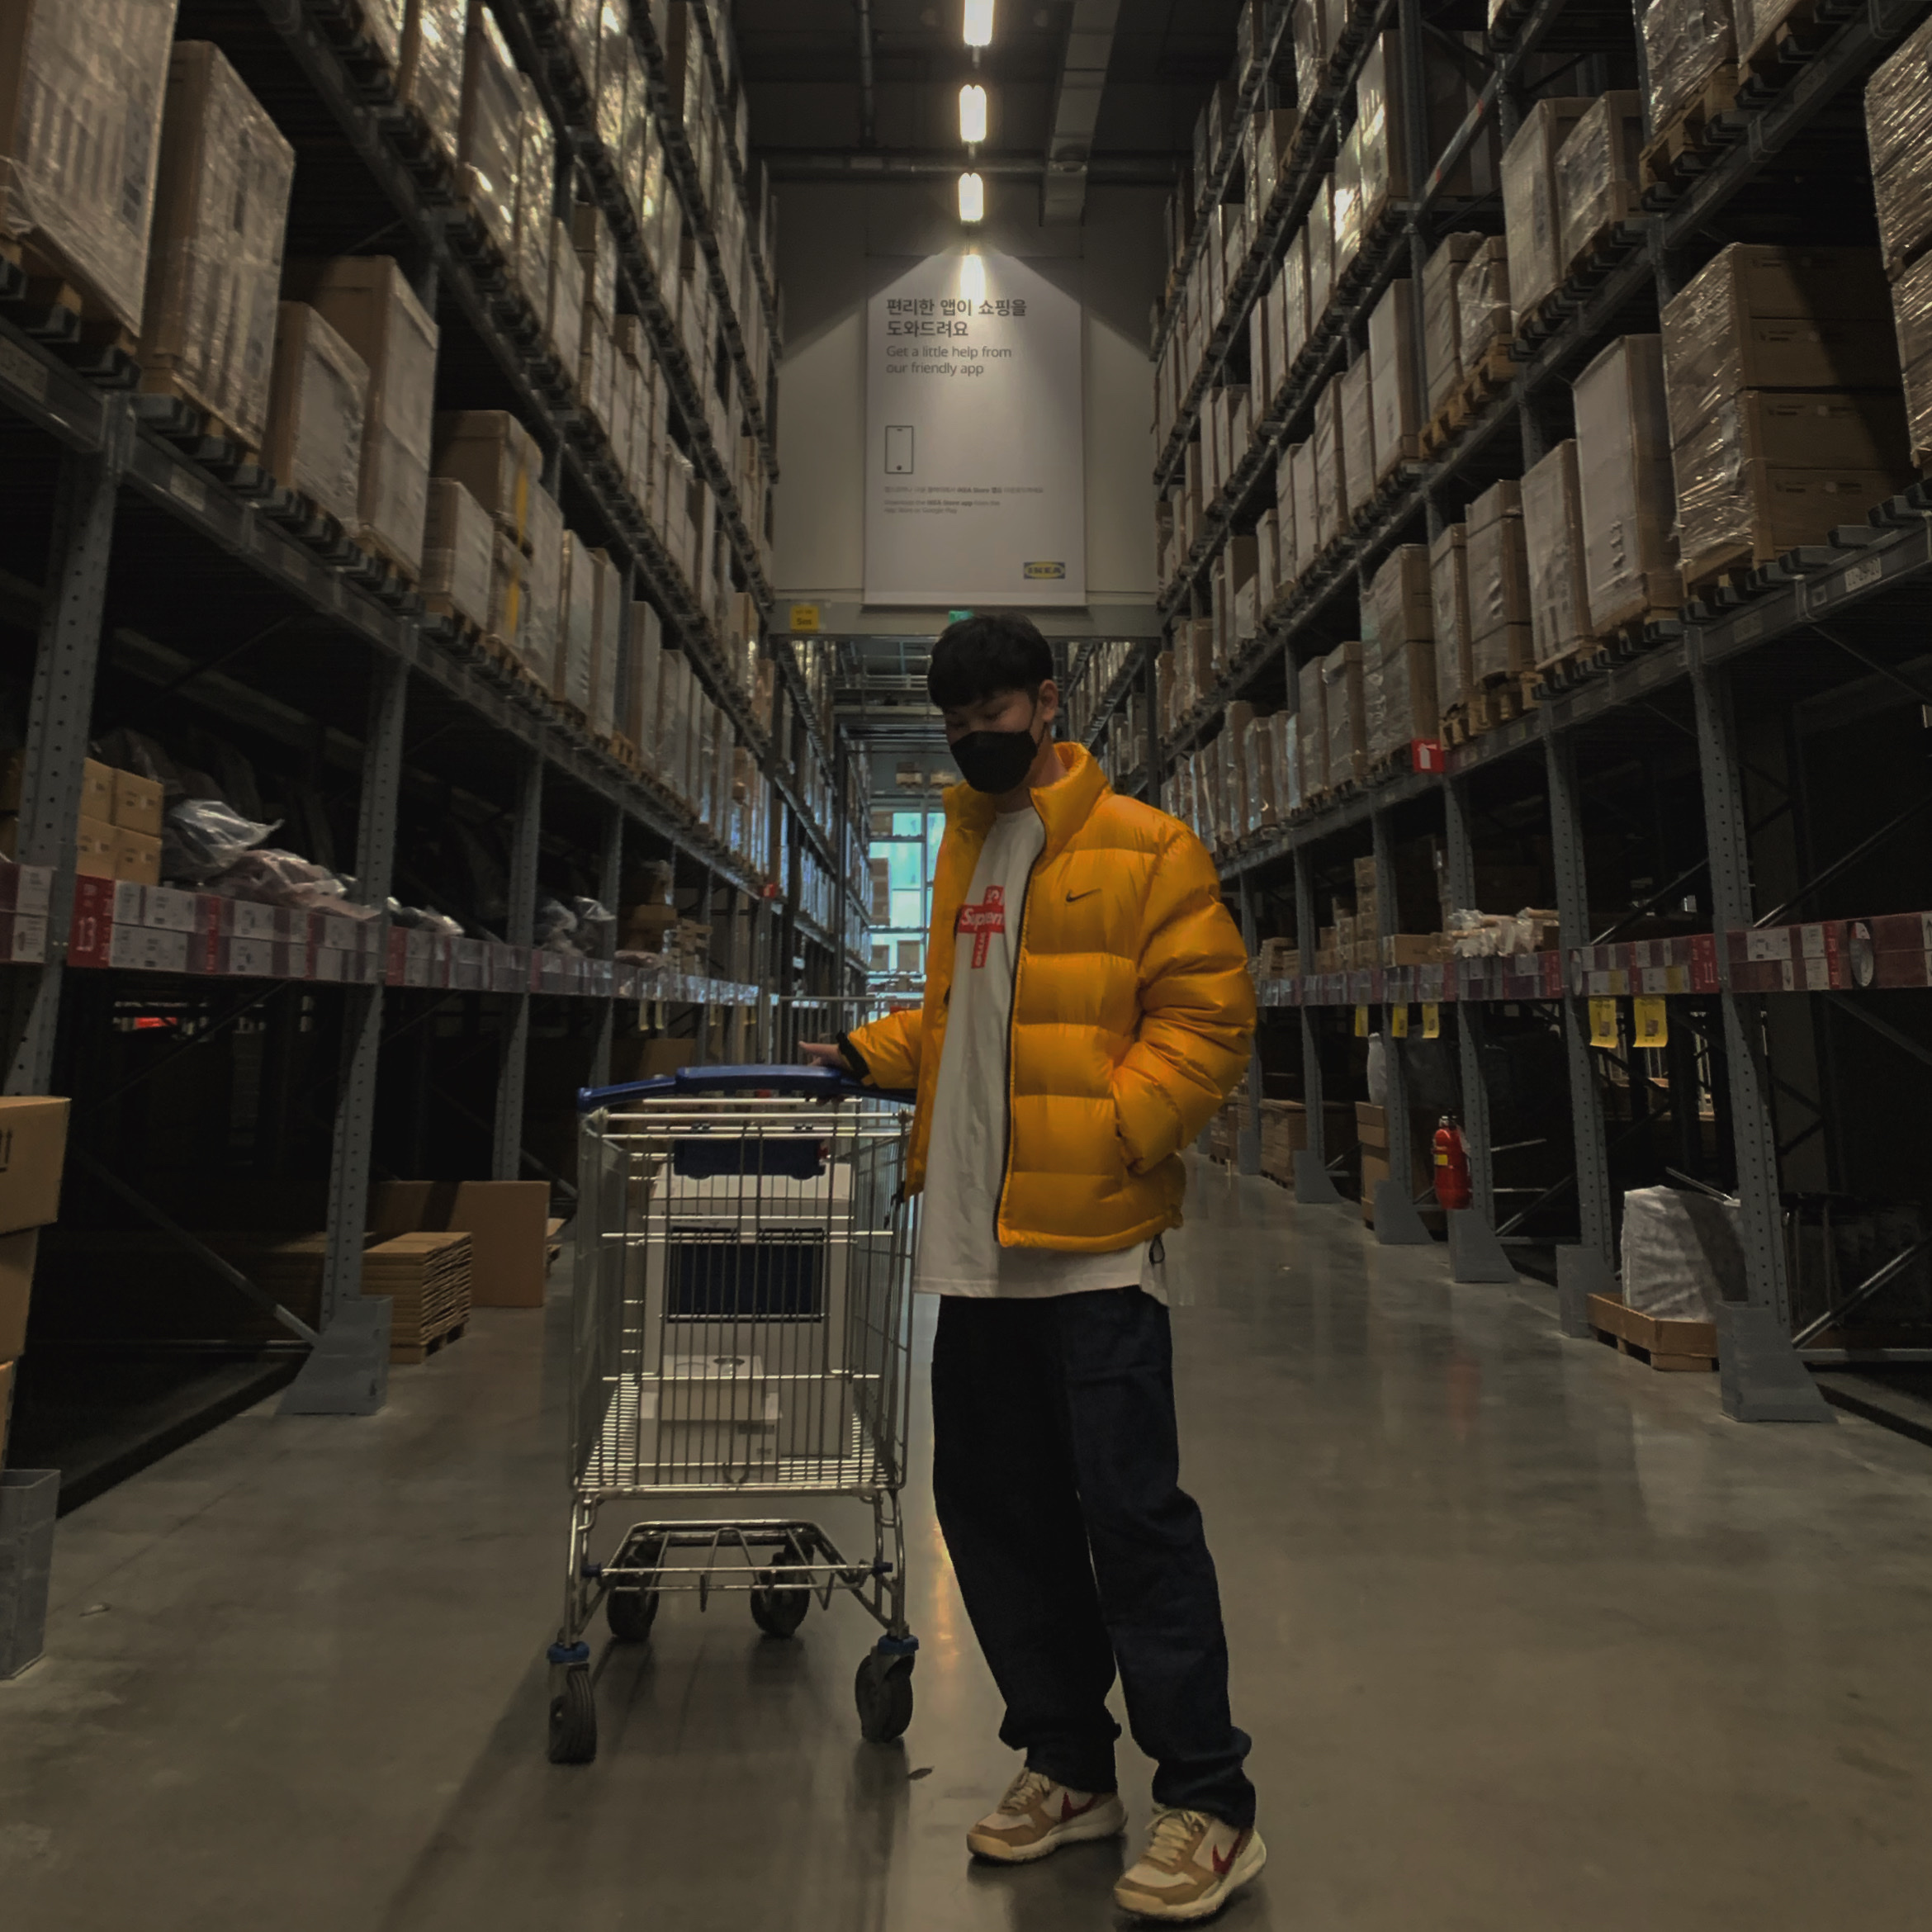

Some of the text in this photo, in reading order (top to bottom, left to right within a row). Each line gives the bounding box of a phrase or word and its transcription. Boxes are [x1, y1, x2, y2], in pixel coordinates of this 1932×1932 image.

[886, 299, 1027, 317] 편리한 앱이 쇼핑을
[886, 320, 968, 338] 도와드려요
[886, 345, 1012, 360] Get a little help from
[886, 362, 984, 377] our friendly app
